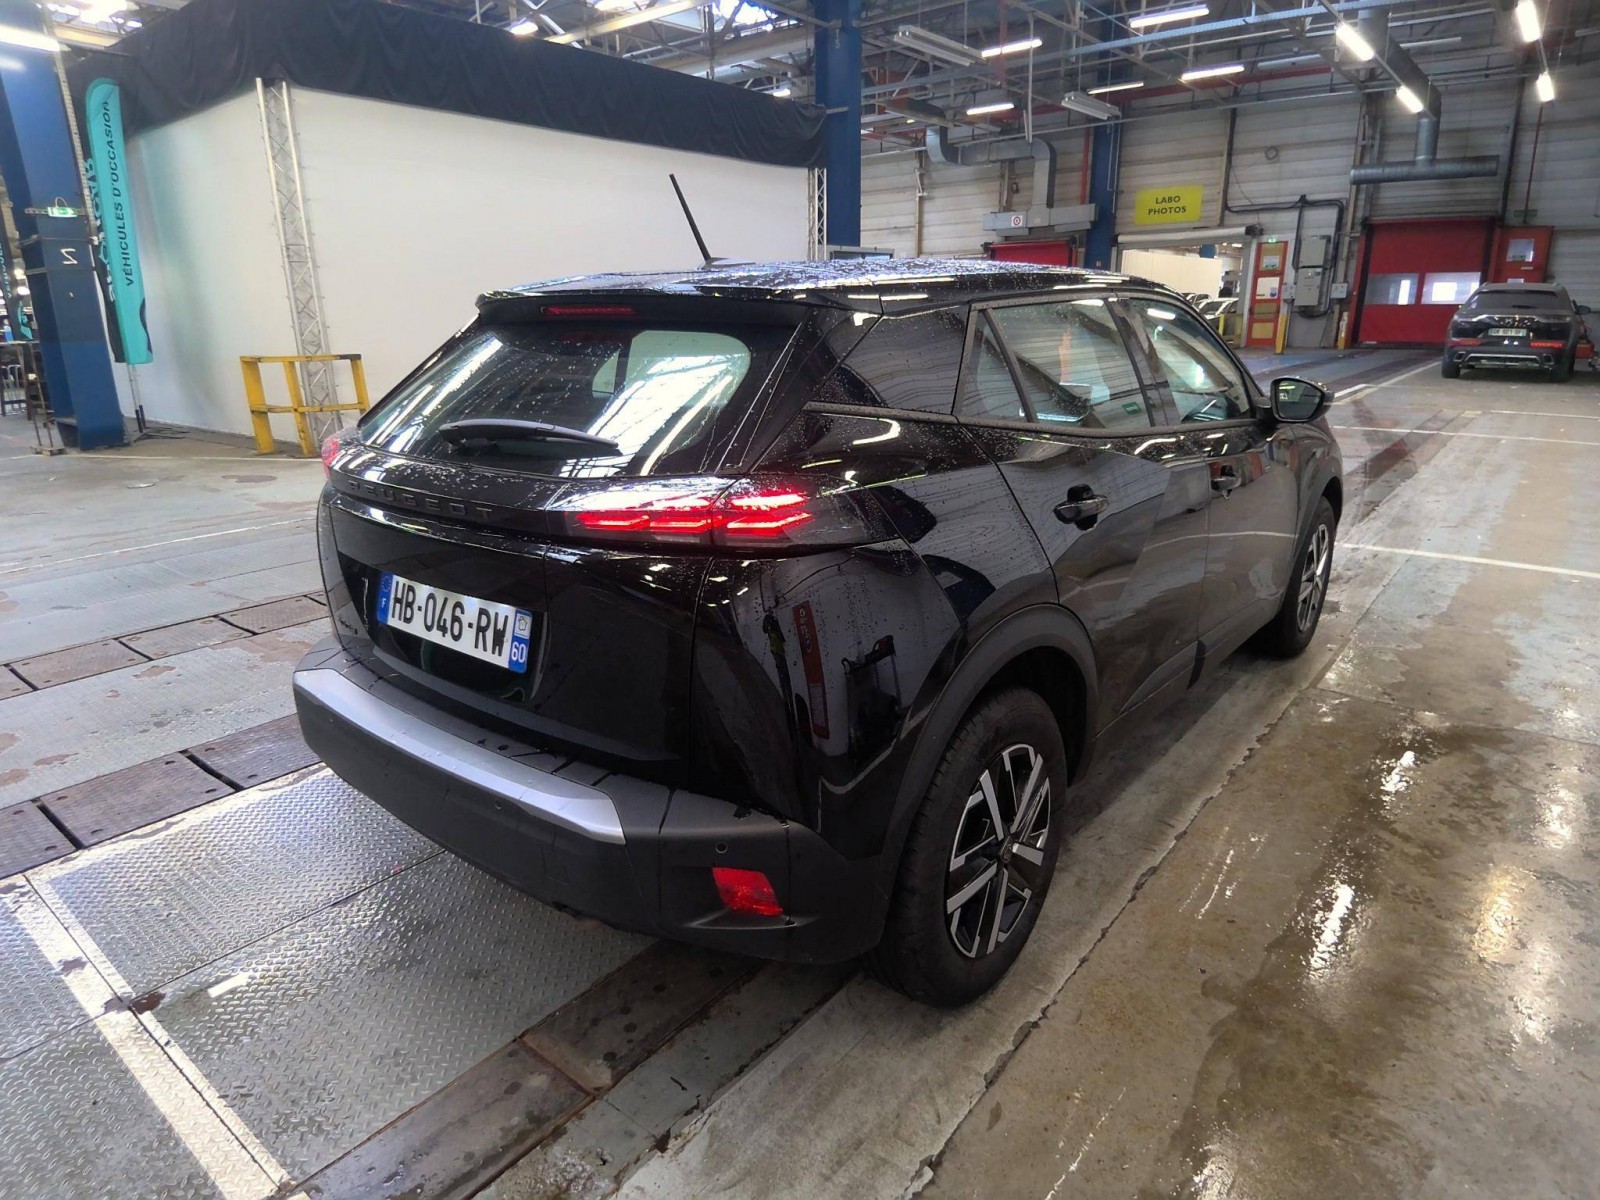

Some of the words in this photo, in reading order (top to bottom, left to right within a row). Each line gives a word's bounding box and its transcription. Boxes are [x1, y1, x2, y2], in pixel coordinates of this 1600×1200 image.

[1147, 205, 1187, 216] PHOTOS
[1155, 195, 1181, 205] LABO
[113, 202, 135, 287] VÉHICULES
[348, 479, 493, 520] PEUGEOT
[391, 580, 509, 657] HB-046-RW
[510, 641, 527, 663] 60
